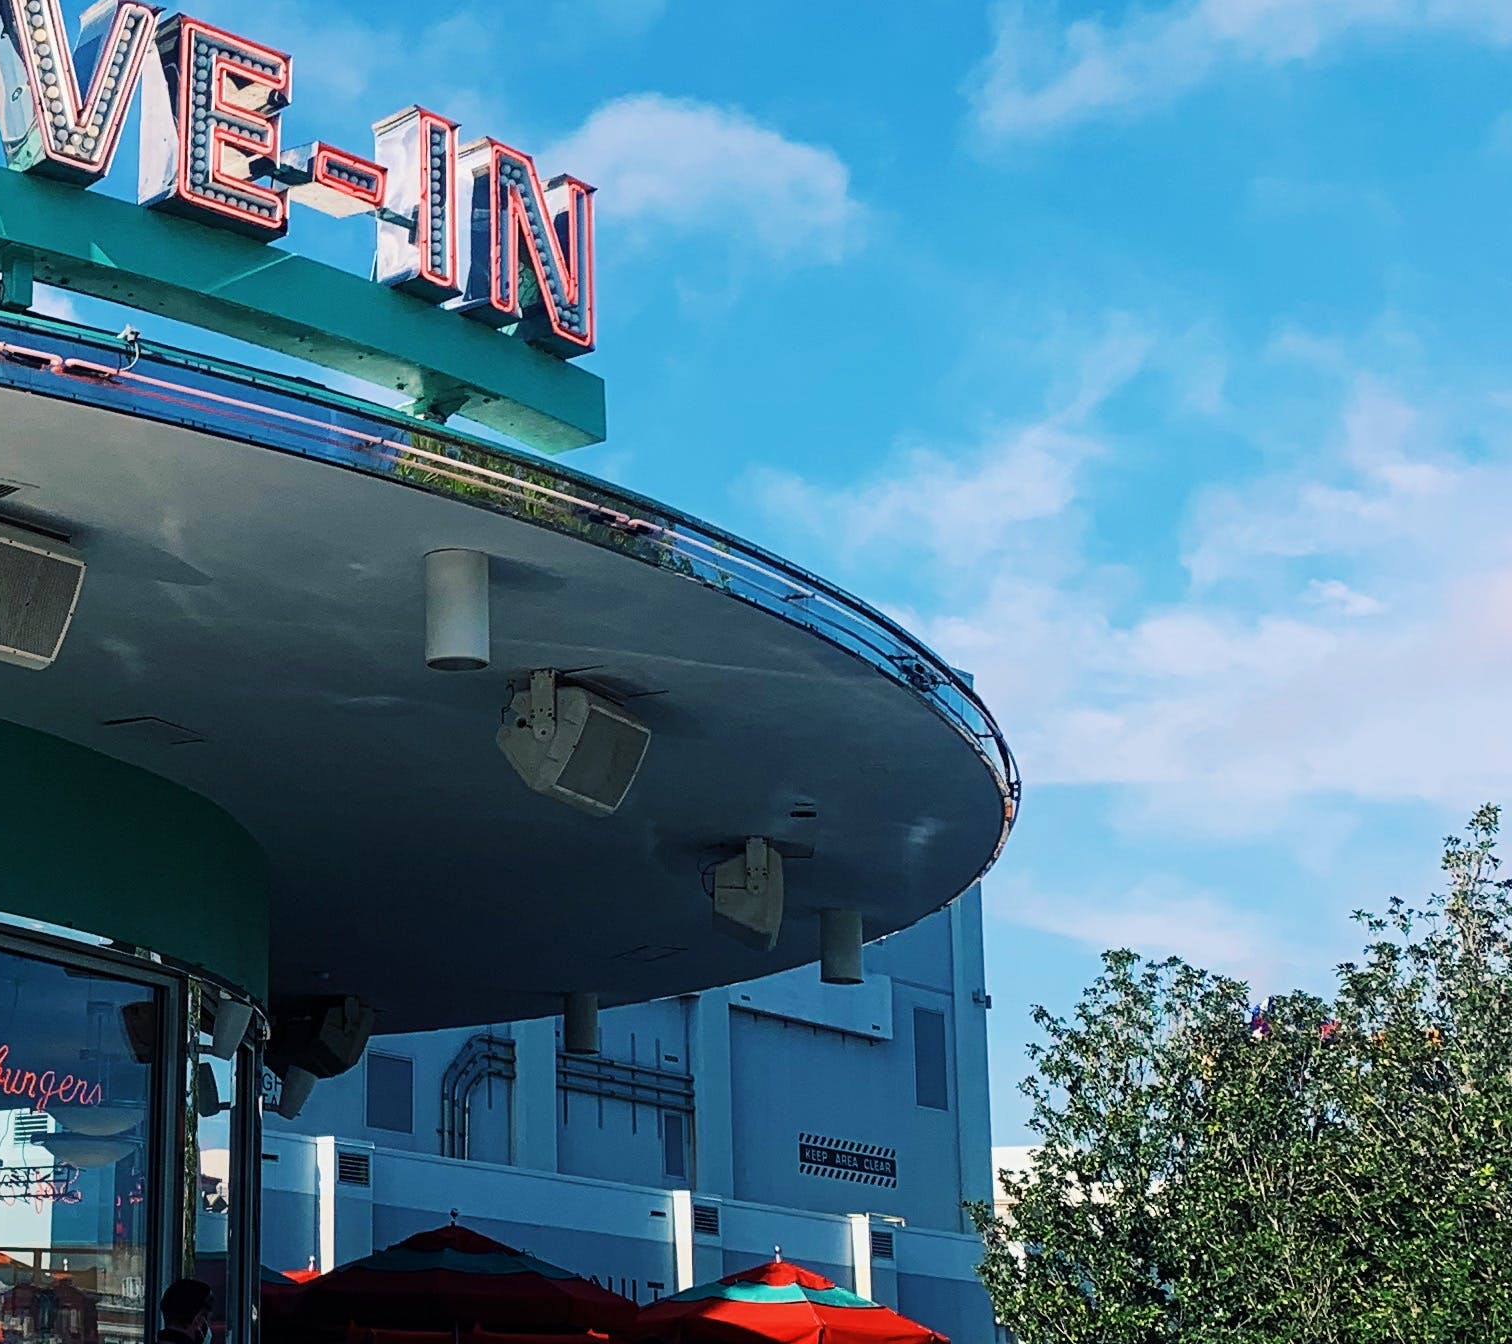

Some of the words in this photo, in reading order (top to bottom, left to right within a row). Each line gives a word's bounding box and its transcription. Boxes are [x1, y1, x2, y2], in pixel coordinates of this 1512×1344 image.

[804, 1147, 829, 1163] KEEP
[834, 1152, 859, 1168] AREA
[863, 1158, 892, 1174] CLEAR
